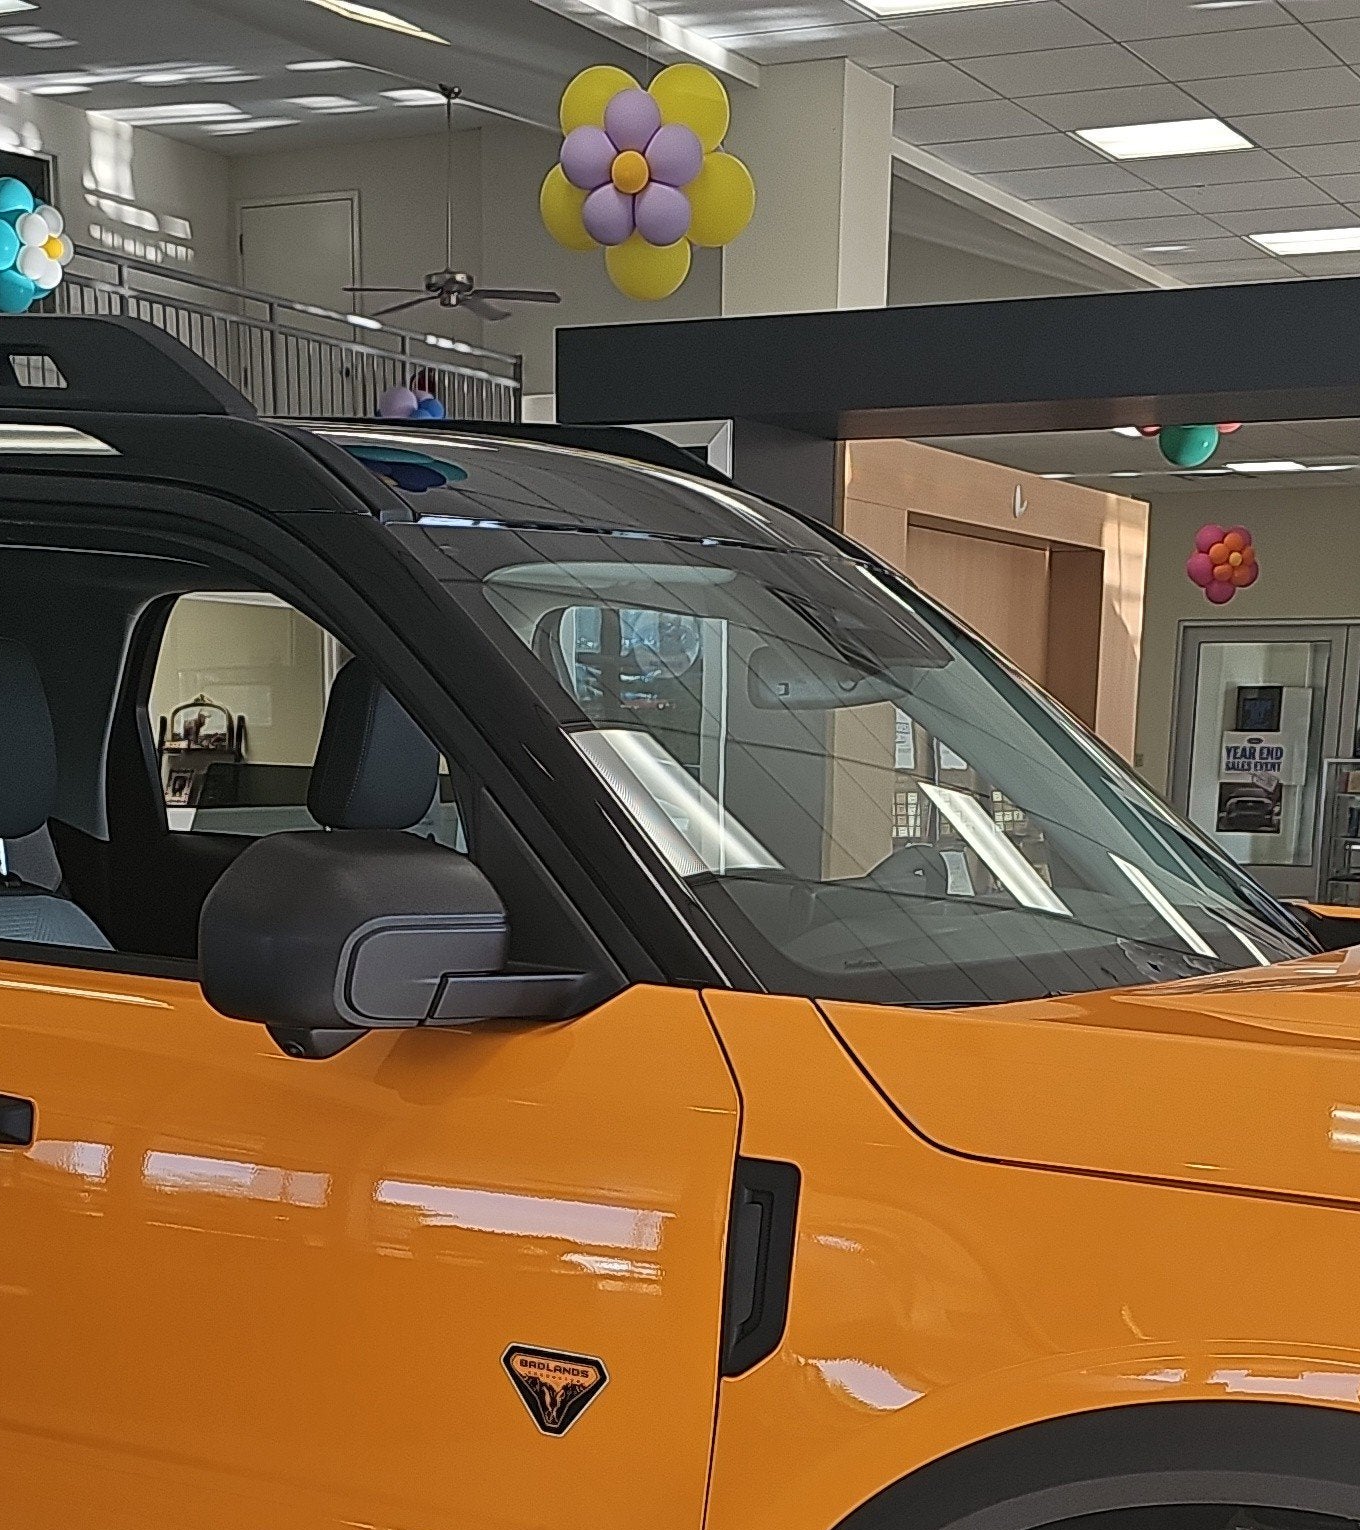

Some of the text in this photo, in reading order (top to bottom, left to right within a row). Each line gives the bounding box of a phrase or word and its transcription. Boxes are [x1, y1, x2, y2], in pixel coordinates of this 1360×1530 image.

[1225, 746, 1283, 760] YEAR END
[1225, 761, 1282, 772] SALES EVENT
[519, 1358, 590, 1379] BADLANDS
